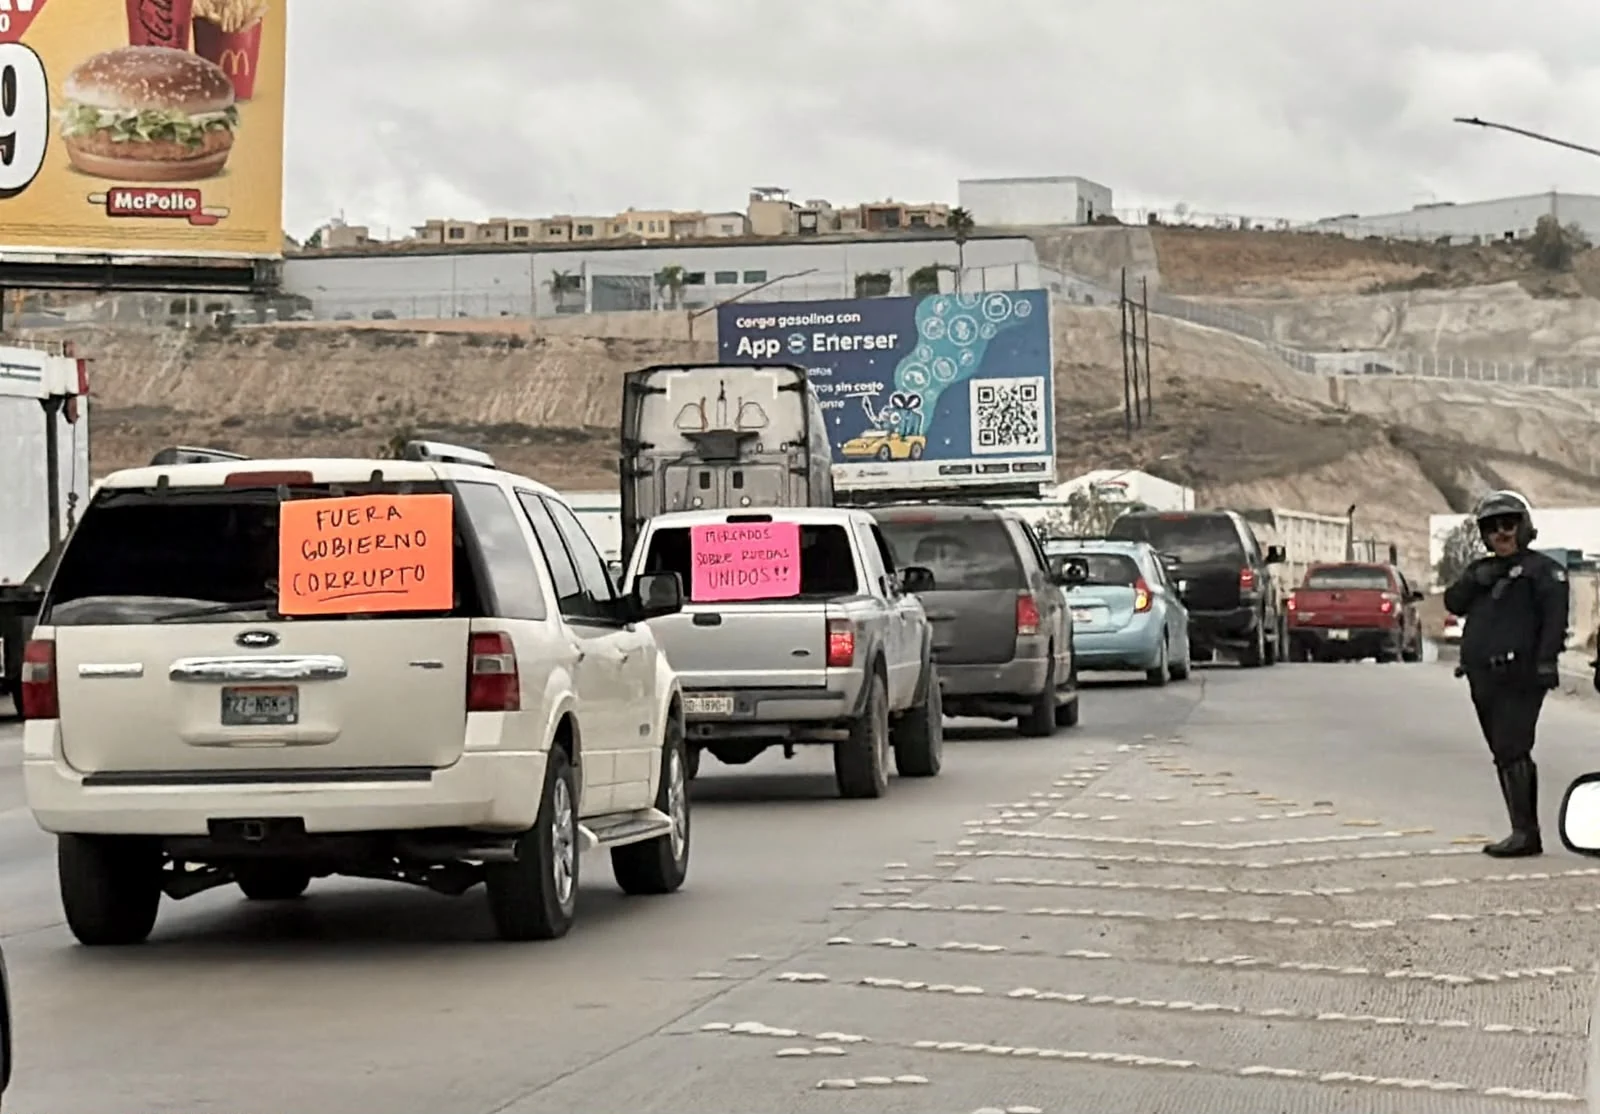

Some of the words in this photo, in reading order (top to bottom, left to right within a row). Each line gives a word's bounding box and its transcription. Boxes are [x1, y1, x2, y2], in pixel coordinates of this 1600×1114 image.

[114, 191, 197, 210] McPollo
[778, 313, 834, 328] gasolina
[836, 312, 861, 323] con
[736, 336, 781, 359] App
[812, 332, 898, 351] Enerser
[835, 381, 852, 391] sin
[854, 381, 884, 391] costo
[316, 505, 402, 531] FUERA
[302, 530, 427, 561] GOBIERNO
[705, 528, 772, 543] MERCADOS
[696, 552, 733, 566] SOBRE
[742, 548, 790, 561] RUEDAS
[293, 564, 426, 597] CORRUPTO
[708, 566, 789, 589] UNIDOS!!
